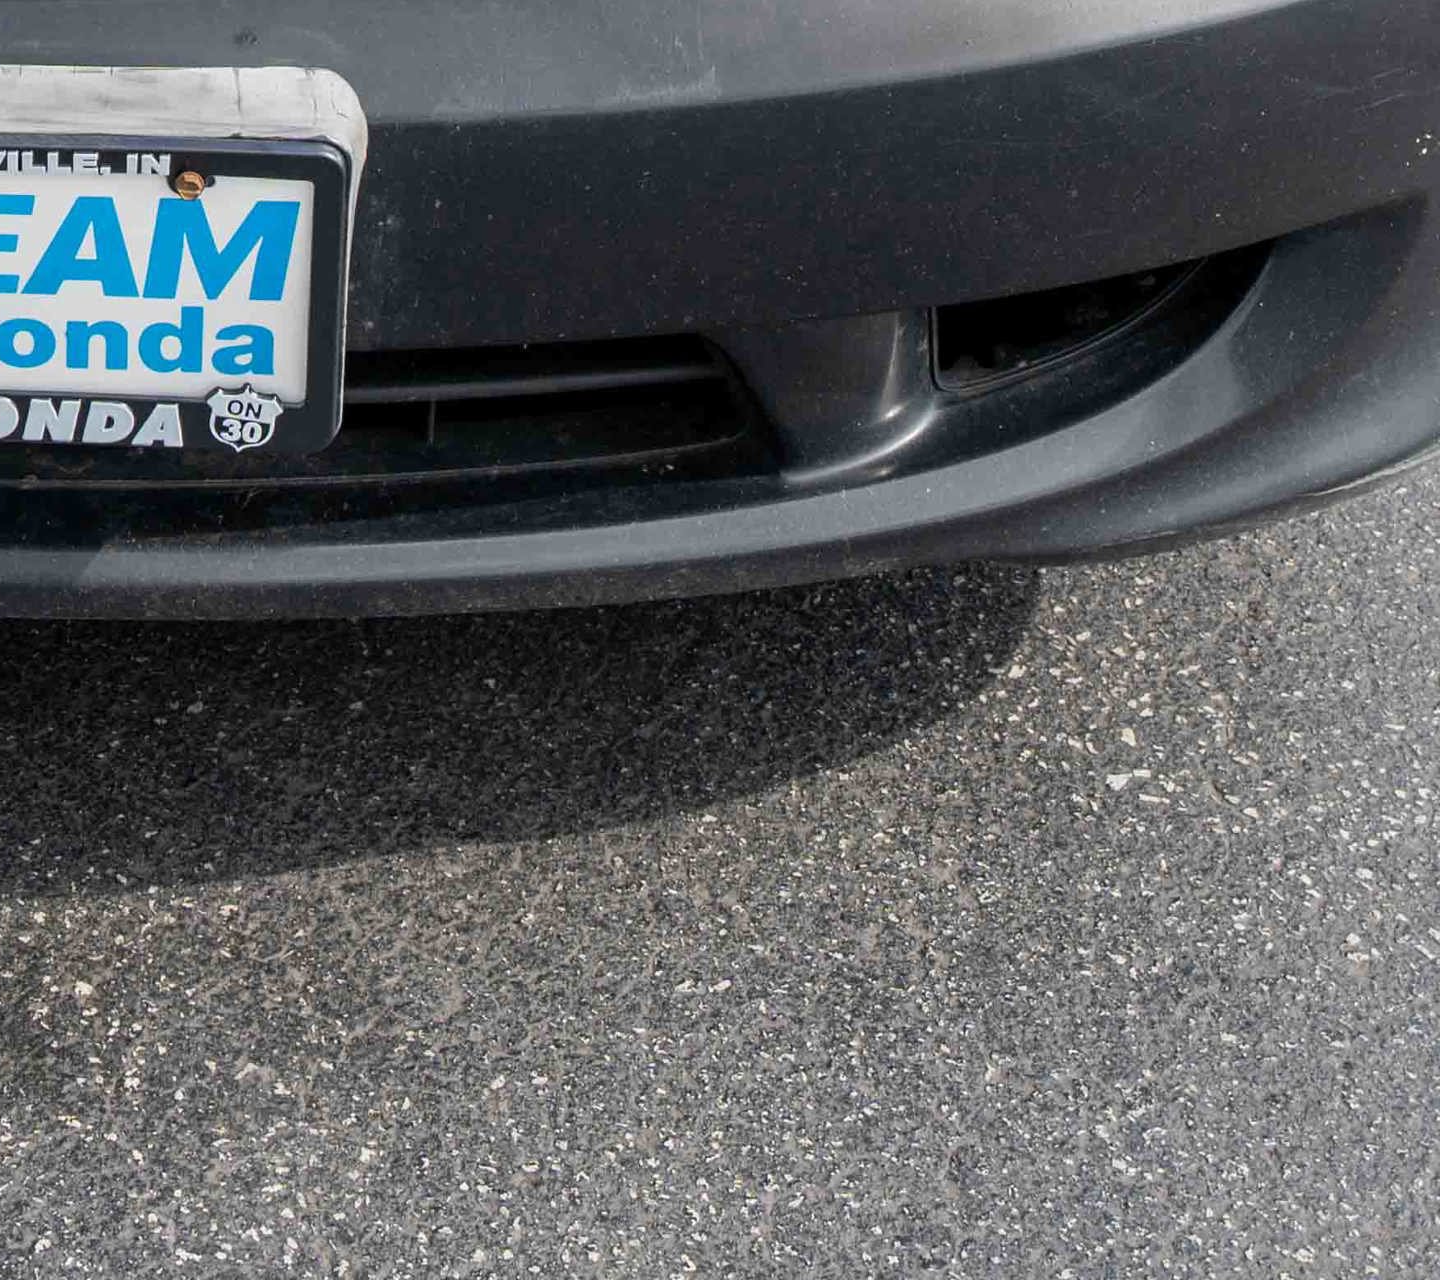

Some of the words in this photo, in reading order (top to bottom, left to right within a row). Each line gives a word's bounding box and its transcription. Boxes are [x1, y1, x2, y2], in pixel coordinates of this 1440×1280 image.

[124, 153, 172, 177] IN
[227, 399, 263, 420] ON
[219, 418, 263, 444] 30
